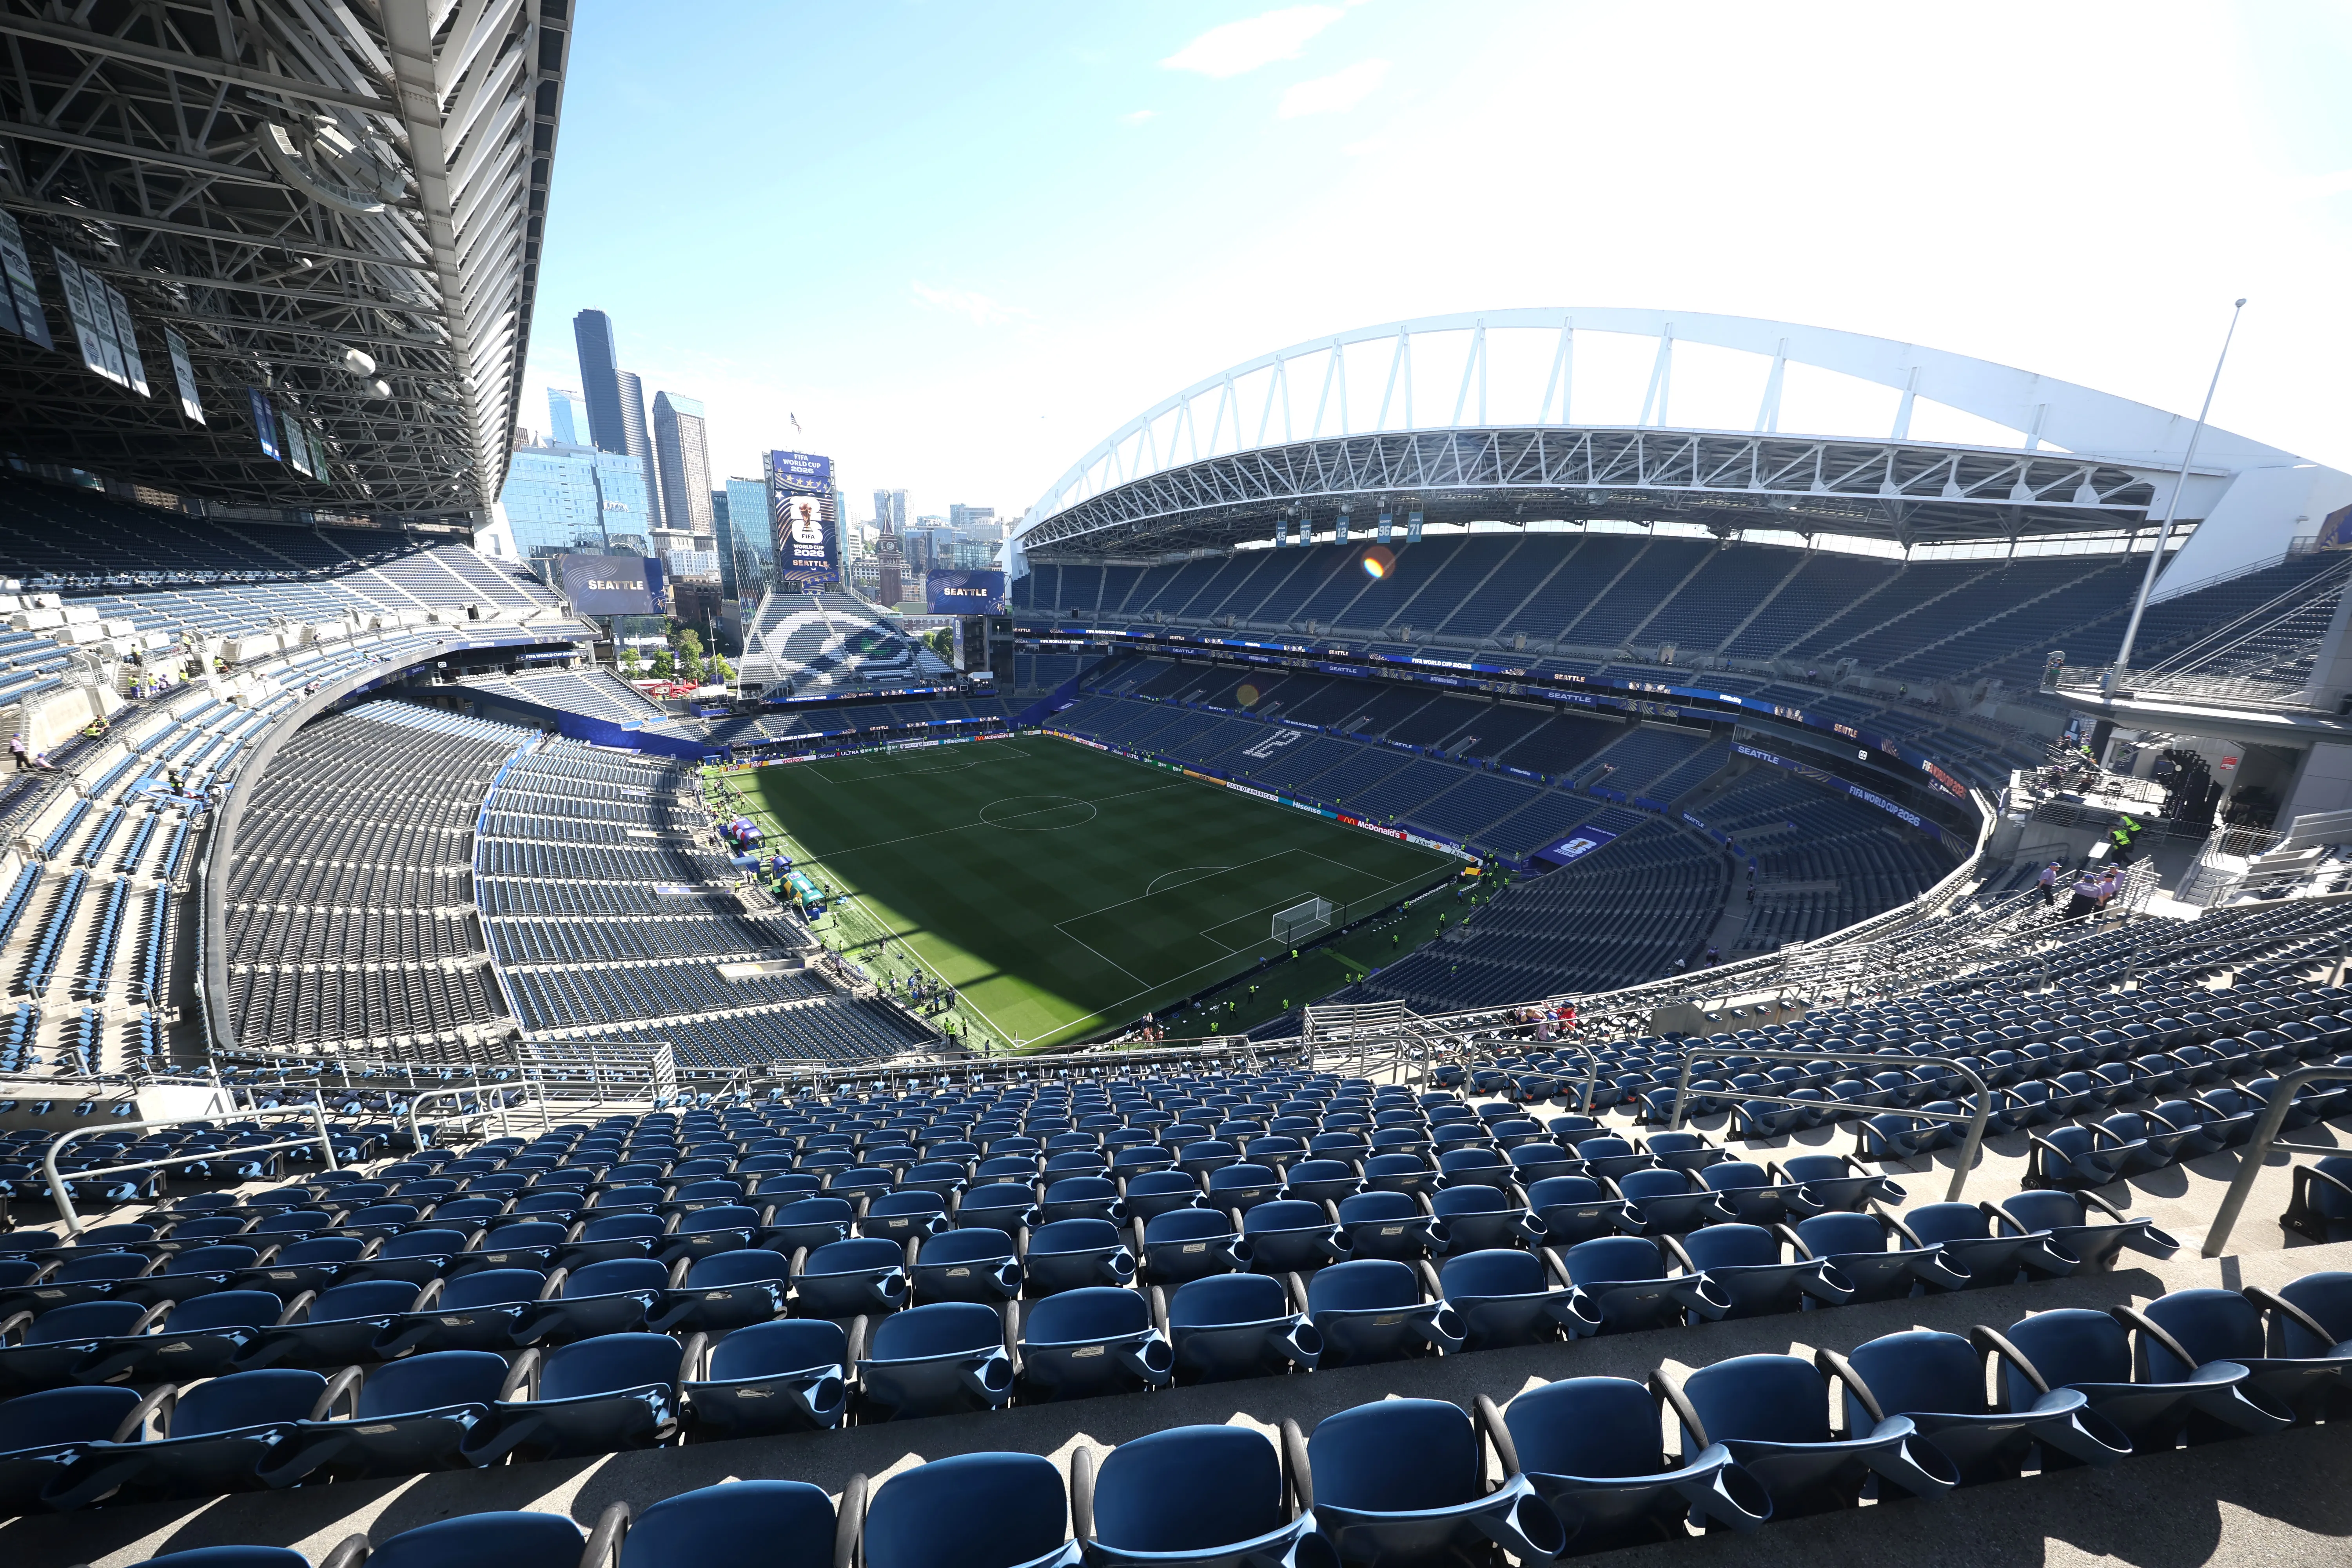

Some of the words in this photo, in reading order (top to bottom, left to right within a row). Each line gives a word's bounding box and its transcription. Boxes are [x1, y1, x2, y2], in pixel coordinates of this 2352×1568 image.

[1301, 530, 1310, 540] 80
[1337, 527, 1347, 538] 12
[1379, 525, 1390, 536] 96
[1410, 524, 1419, 535] 71
[1276, 531, 1286, 541] 45
[588, 579, 644, 590] SEATTLE
[944, 588, 987, 597] SEATTLE
[1430, 676, 1457, 685] #FIFAWorldCup
[1554, 673, 1585, 682] SEATTLE
[1548, 692, 1592, 703] SEATTLE
[1834, 723, 1858, 738] SEATTLE
[1391, 740, 1412, 749] EATTLE
[1738, 746, 1779, 764] SEATTLE
[1249, 788, 1271, 799] AMERICA
[1293, 801, 1321, 815] Hisense
[1849, 786, 1863, 799] FIFA
[1864, 791, 1886, 809] WORLD
[1886, 801, 1899, 815] CUP
[1897, 808, 1921, 827] 2026
[1683, 813, 1705, 829] SEATTLE
[1357, 820, 1400, 839] McDonald's
[1414, 837, 1431, 848] Dove
[1450, 848, 1466, 858] Dove
[1553, 850, 1575, 858] 2026
